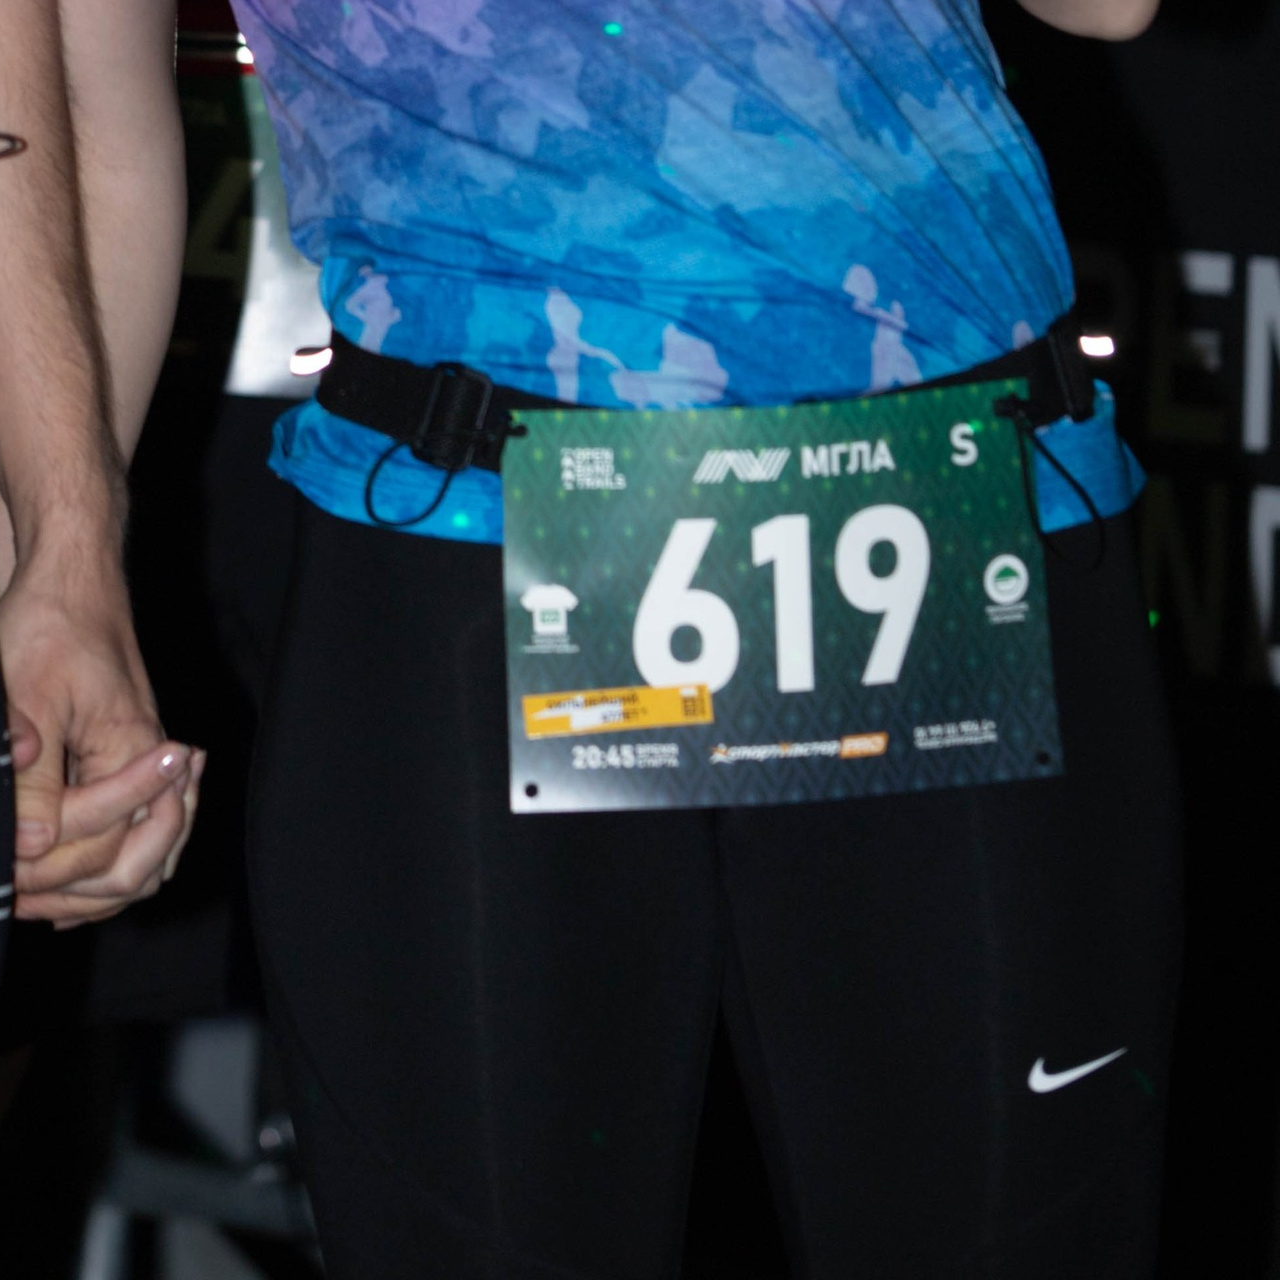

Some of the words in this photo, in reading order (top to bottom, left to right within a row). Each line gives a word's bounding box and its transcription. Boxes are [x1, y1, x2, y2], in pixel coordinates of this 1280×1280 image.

[800, 440, 896, 479] МГЛА
[950, 422, 980, 467] S
[632, 503, 931, 694] 619
[571, 743, 635, 771] 20:45
